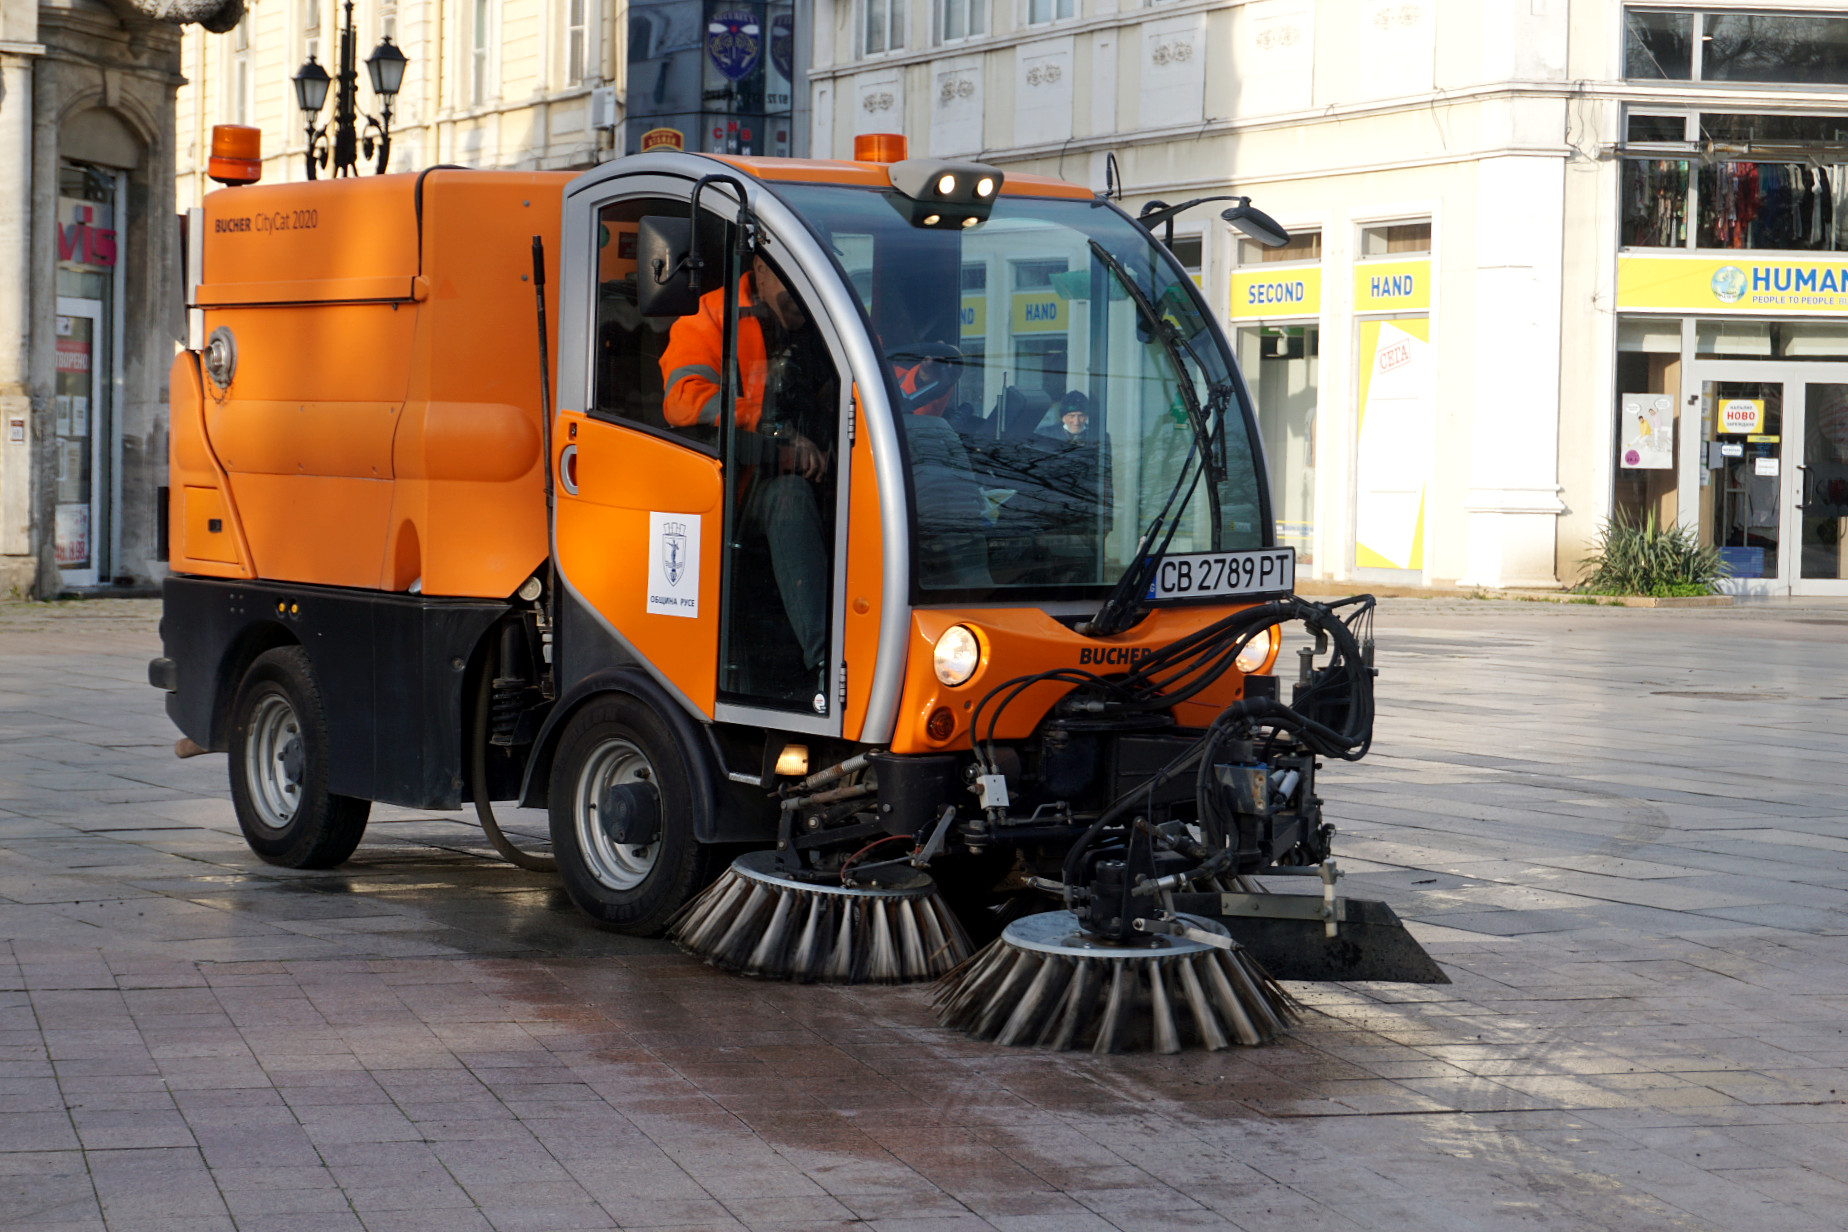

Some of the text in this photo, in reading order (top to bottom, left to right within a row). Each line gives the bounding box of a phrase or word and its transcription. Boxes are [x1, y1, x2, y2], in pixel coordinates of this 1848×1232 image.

[215, 209, 318, 235] BUCHER CityCat 2020
[1248, 275, 1413, 304] SECOND HAND
[1752, 295, 1786, 304] PEOPLE
[1789, 296, 1799, 304] TO
[1801, 296, 1835, 305] PEOPLE
[1025, 303, 1057, 321] HAND
[1379, 344, 1409, 370] СЕГА
[1727, 411, 1755, 420] НОВО
[1161, 555, 1289, 593] CB 2789 PT
[650, 595, 695, 607] ОБЩИНА РУСЕ
